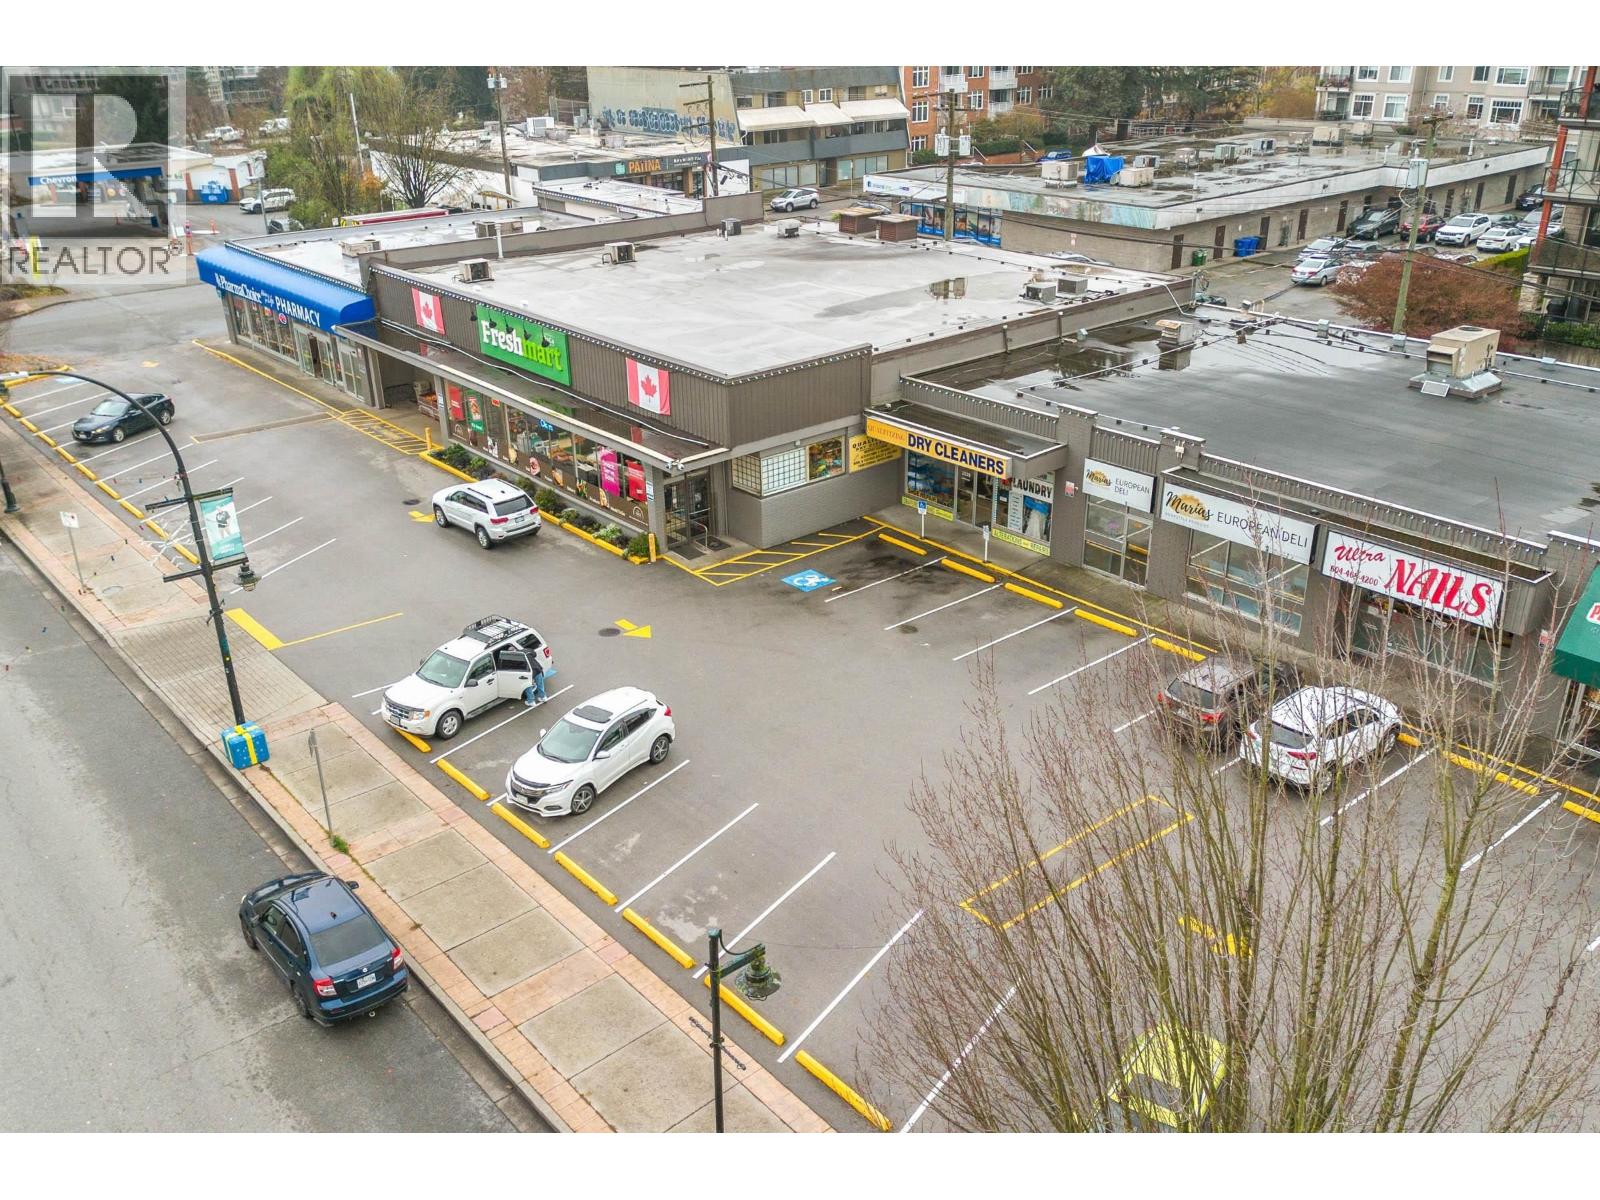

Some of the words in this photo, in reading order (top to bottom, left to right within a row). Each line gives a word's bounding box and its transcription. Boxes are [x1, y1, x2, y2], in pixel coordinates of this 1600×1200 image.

[40, 176, 77, 186] Chevron
[275, 296, 321, 328] PHARMACY
[908, 433, 932, 452] DRY
[934, 442, 1005, 475] CLEANERS
[1012, 478, 1053, 498] LAUNDRY
[1114, 486, 1129, 497] DELI
[1115, 478, 1150, 495] EUROPEAN
[1217, 511, 1280, 539] EUROPEAN
[1281, 530, 1308, 548] DELI
[1334, 545, 1386, 563] Ultra
[1384, 559, 1493, 617] NAILS
